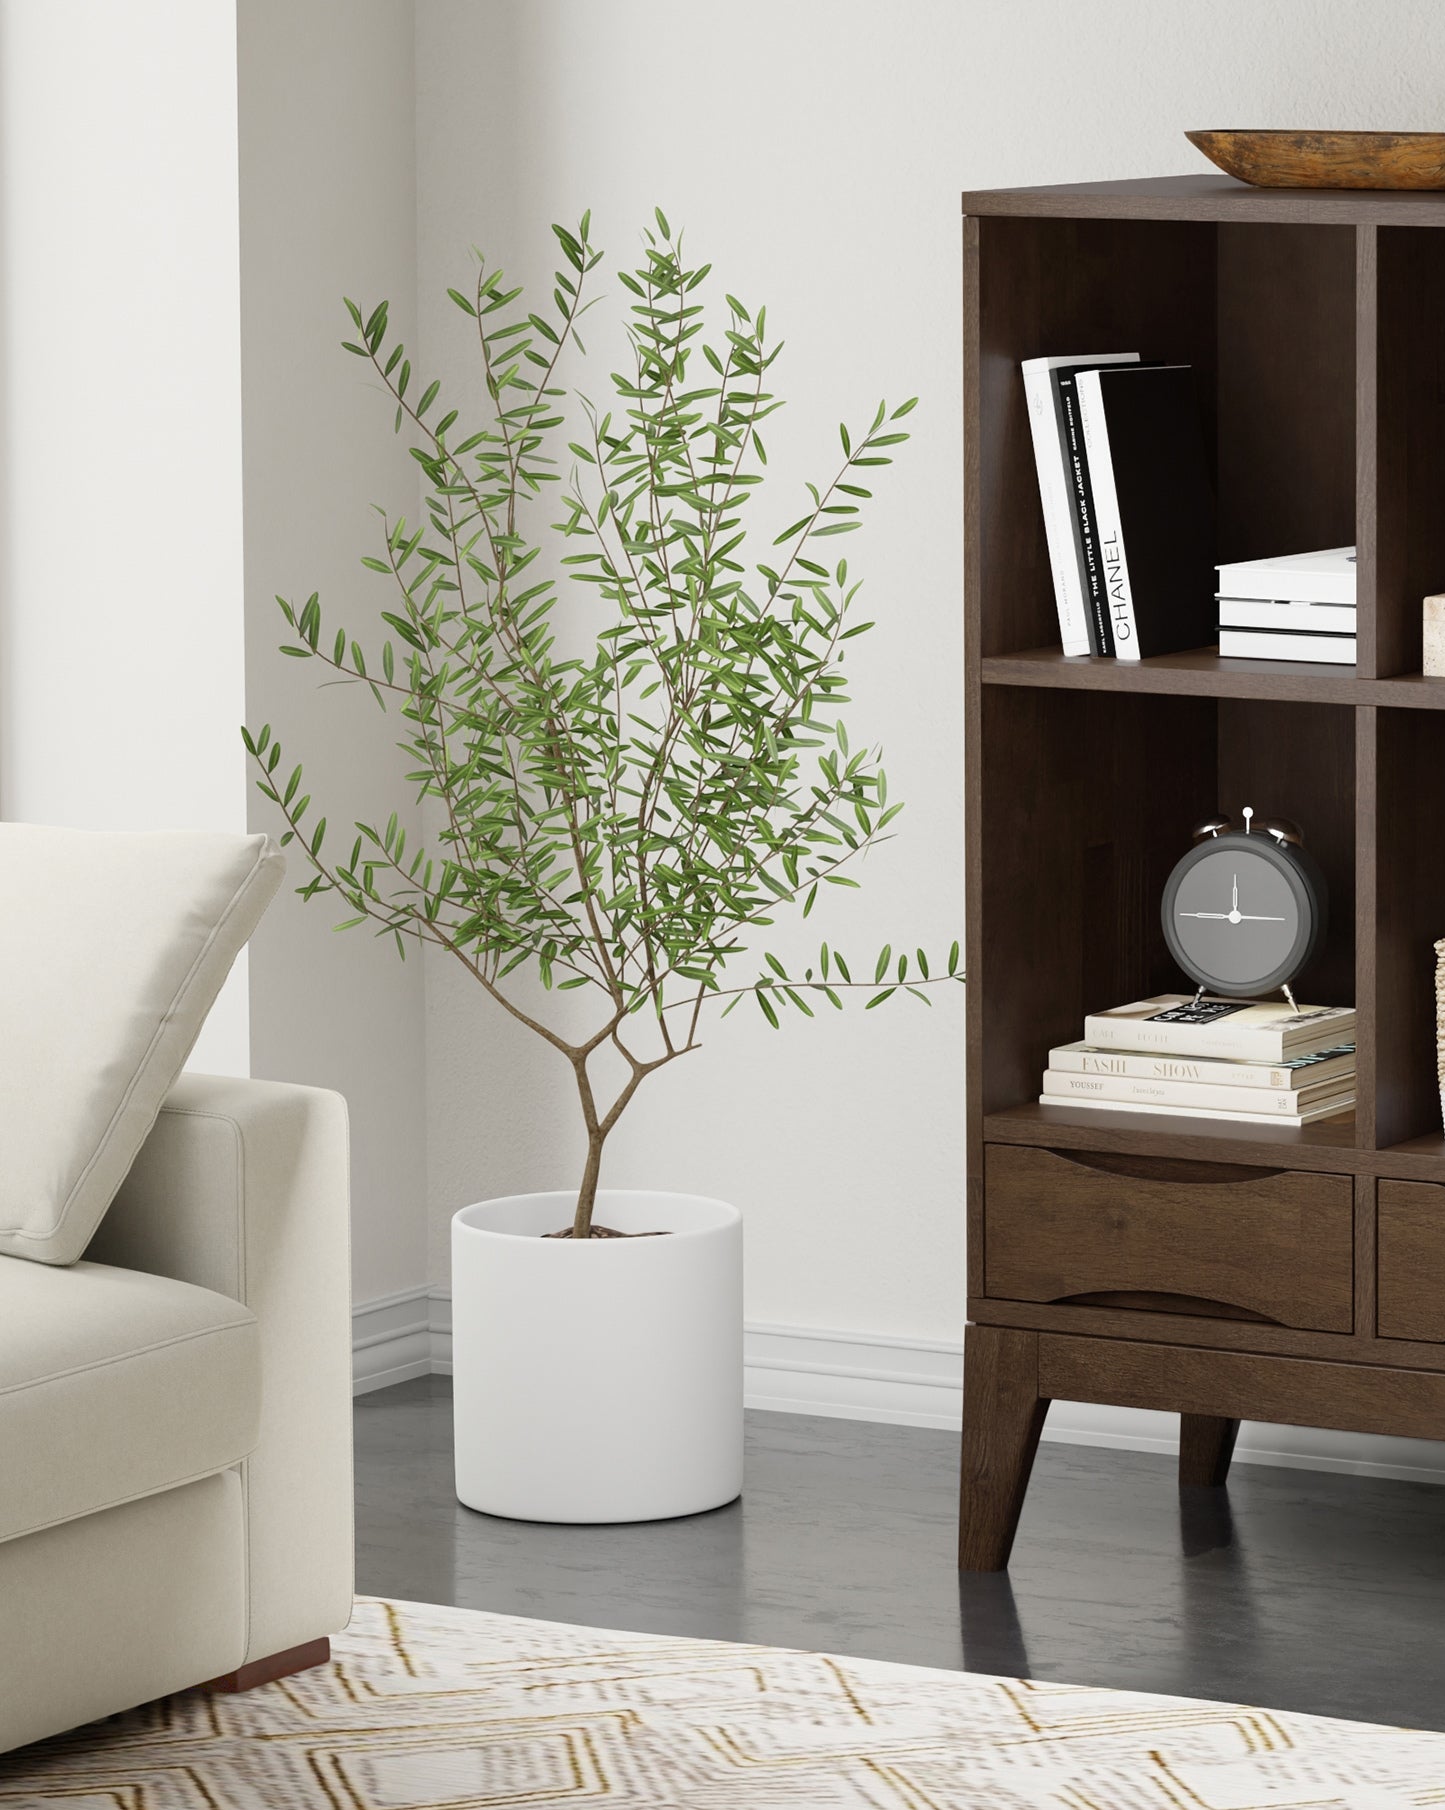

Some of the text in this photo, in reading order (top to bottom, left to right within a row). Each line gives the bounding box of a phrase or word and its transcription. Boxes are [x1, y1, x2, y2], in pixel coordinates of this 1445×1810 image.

[1079, 379, 1092, 448] COLLECTIONS
[1073, 456, 1085, 497] JACKET
[1080, 500, 1090, 534] BLACK
[1086, 537, 1096, 572] LITTLE
[1091, 575, 1099, 597] THE
[1103, 530, 1131, 641] CHANEL
[1154, 1063, 1201, 1079] SHOW
